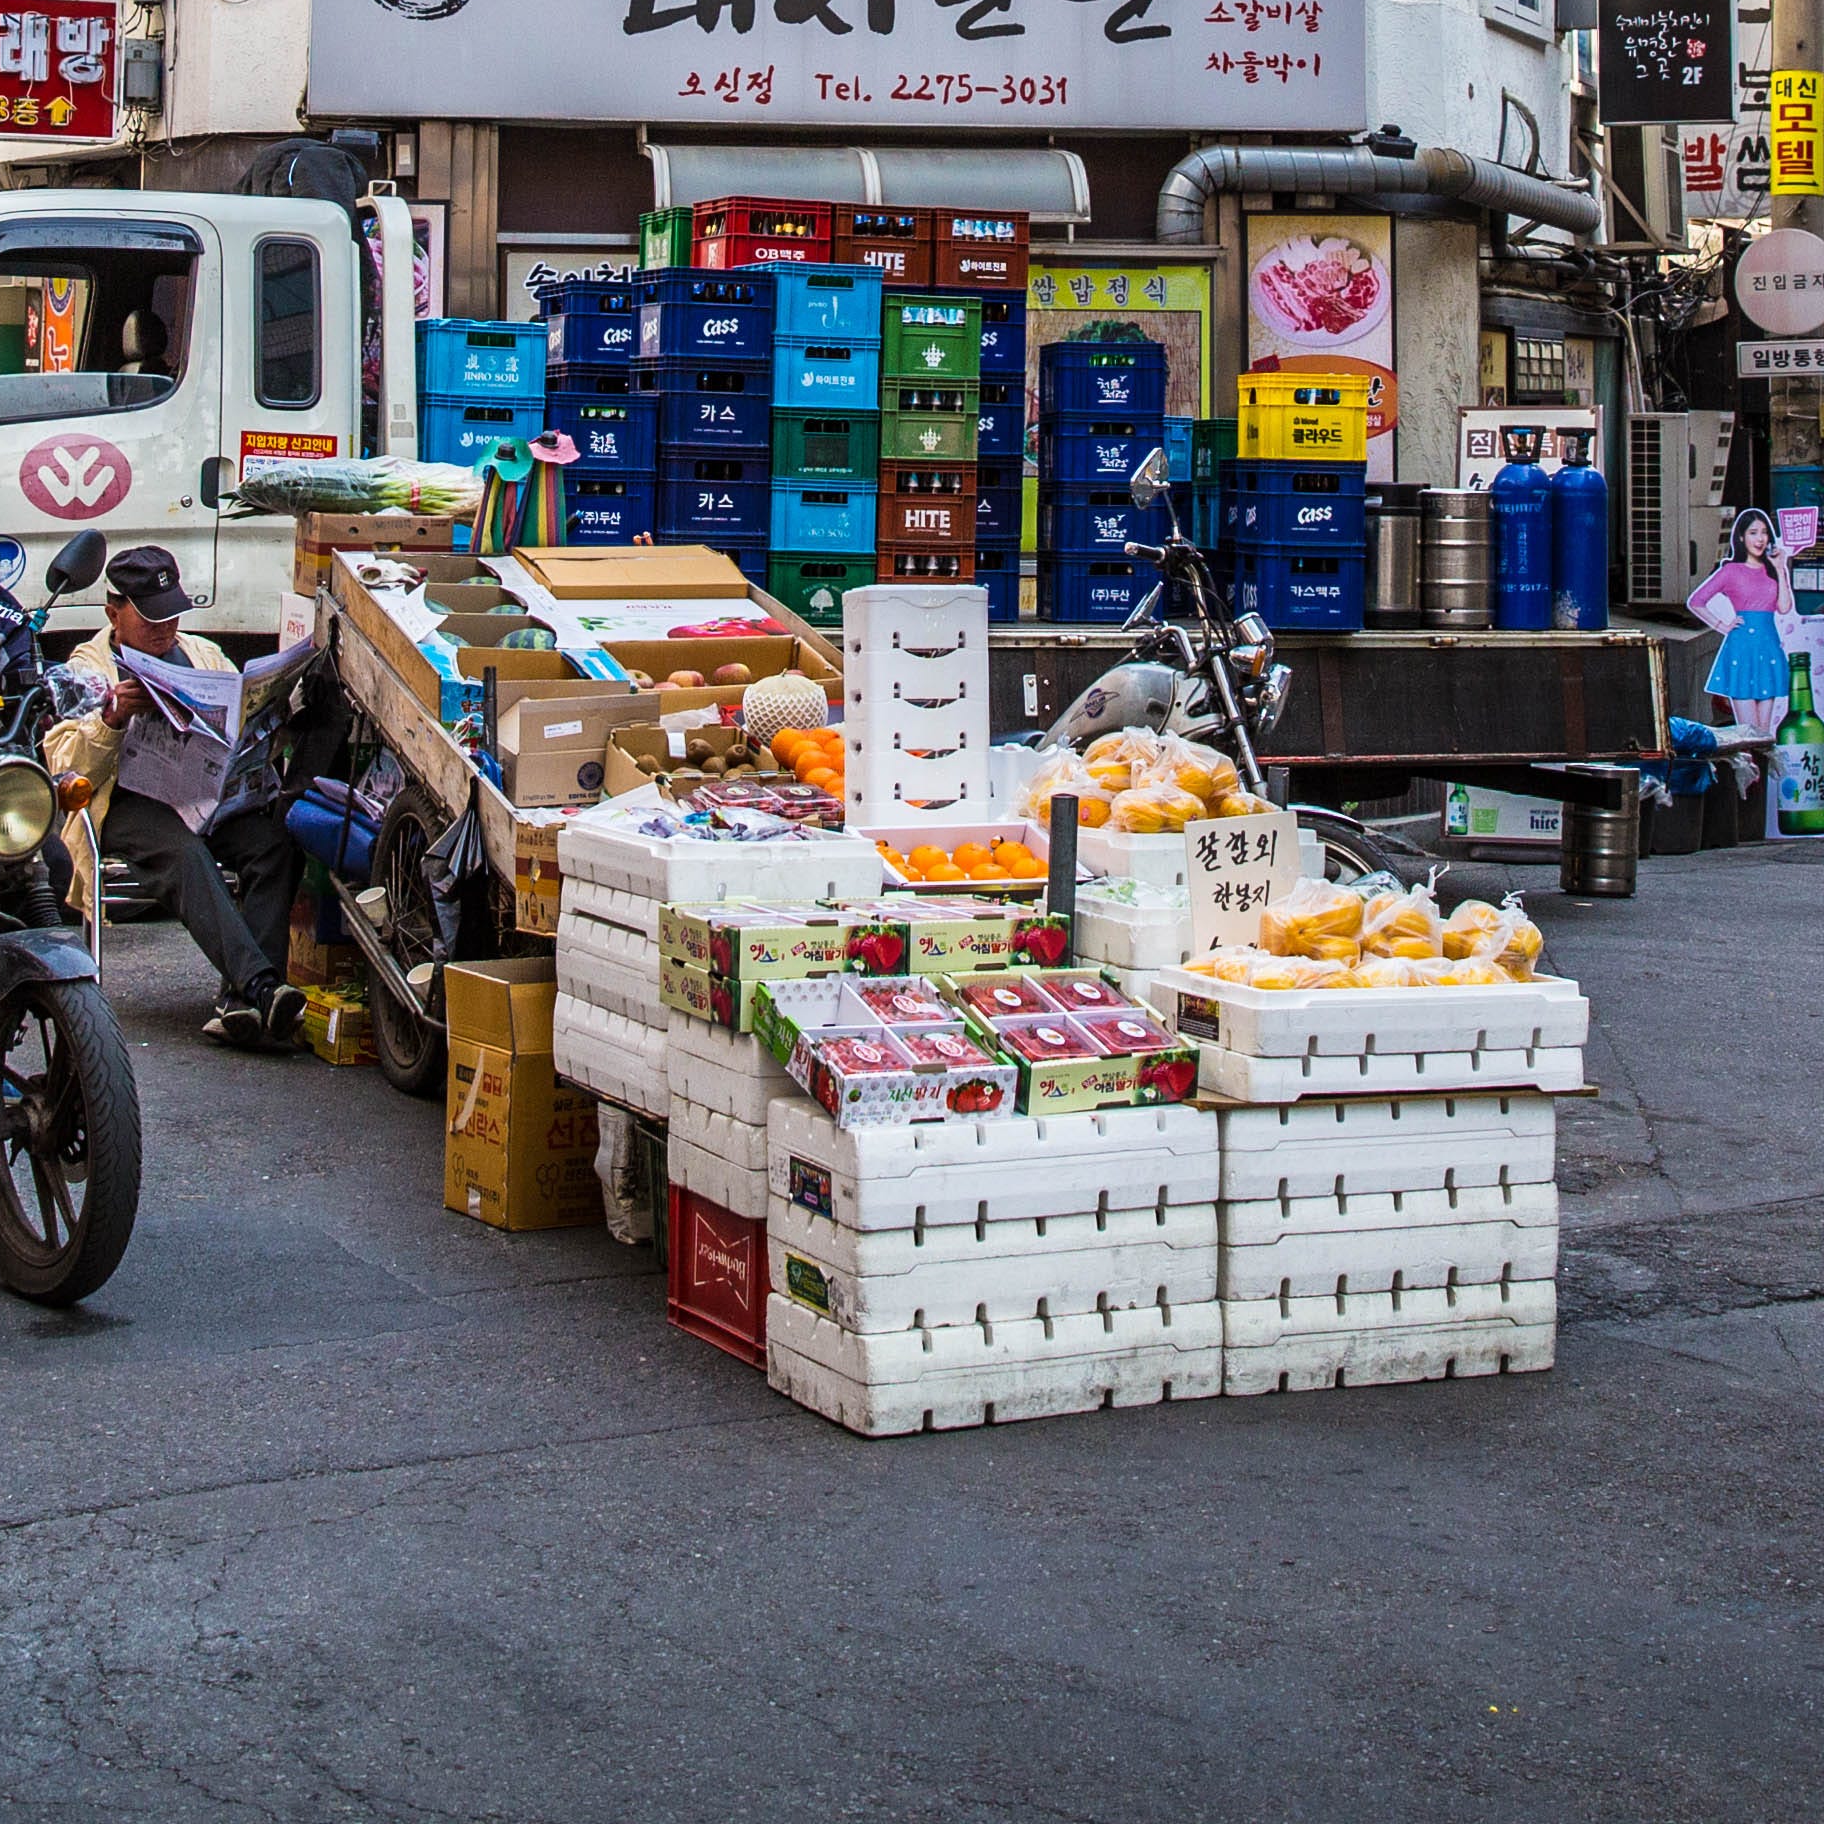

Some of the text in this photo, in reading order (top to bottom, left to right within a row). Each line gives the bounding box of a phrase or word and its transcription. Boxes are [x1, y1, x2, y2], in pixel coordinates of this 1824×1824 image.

[1204, 49, 1323, 87] 차돌박이
[1682, 66, 1704, 85] 2F
[677, 65, 775, 106] 오신정
[815, 71, 1070, 107] Tel. 2275-3031
[1775, 78, 1817, 100] 대신
[1775, 101, 1817, 178] 모텔
[703, 317, 739, 338] Cass
[700, 404, 736, 422] 카스
[245, 433, 333, 452] 지입차량 신고안내
[698, 492, 734, 510] 카스
[904, 509, 951, 528] HITE
[1297, 505, 1334, 525] Cass
[1290, 585, 1341, 599] 카스맥주
